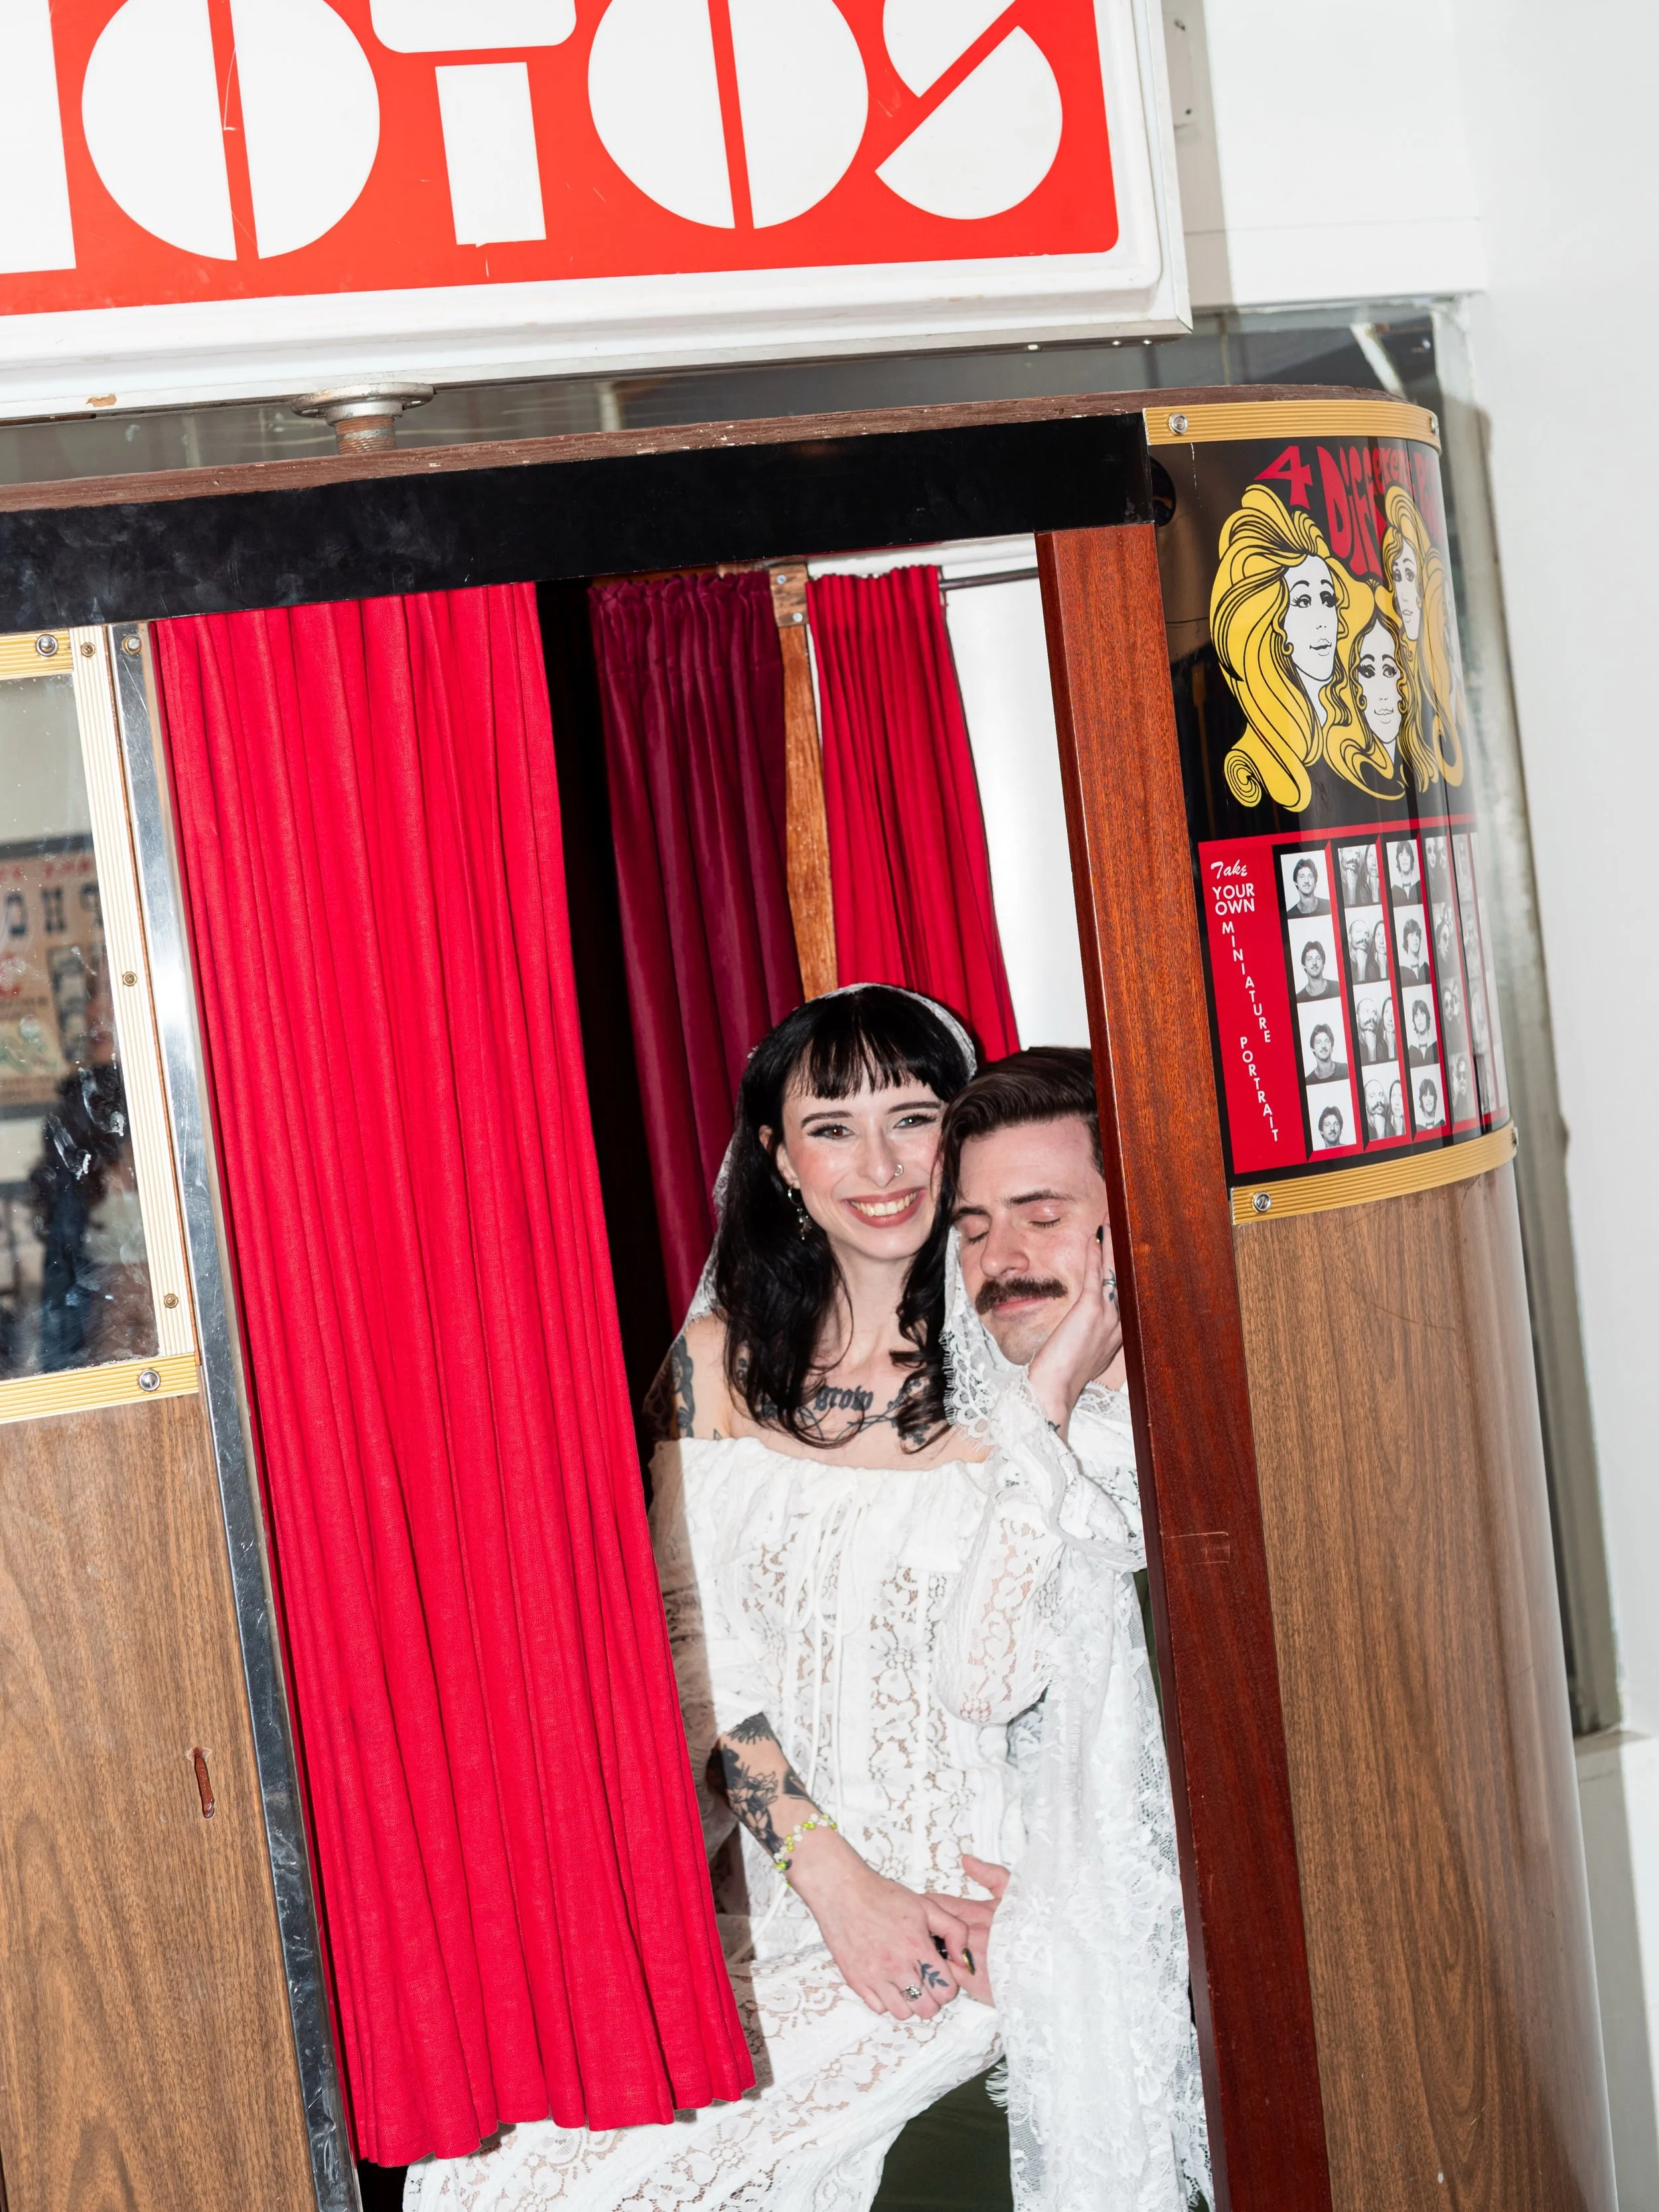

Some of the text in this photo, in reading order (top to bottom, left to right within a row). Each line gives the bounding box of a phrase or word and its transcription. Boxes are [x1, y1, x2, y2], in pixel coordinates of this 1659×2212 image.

[0, 0, 1063, 274] OTOS
[1254, 445, 1313, 510] 4
[1210, 859, 1248, 879] Take
[1212, 883, 1256, 900] YOUR
[1215, 898, 1256, 916] OWN
[1222, 921, 1271, 1043] MINIATURE
[1240, 1036, 1279, 1142] PORTRAIT
[814, 1384, 874, 1412] grow
